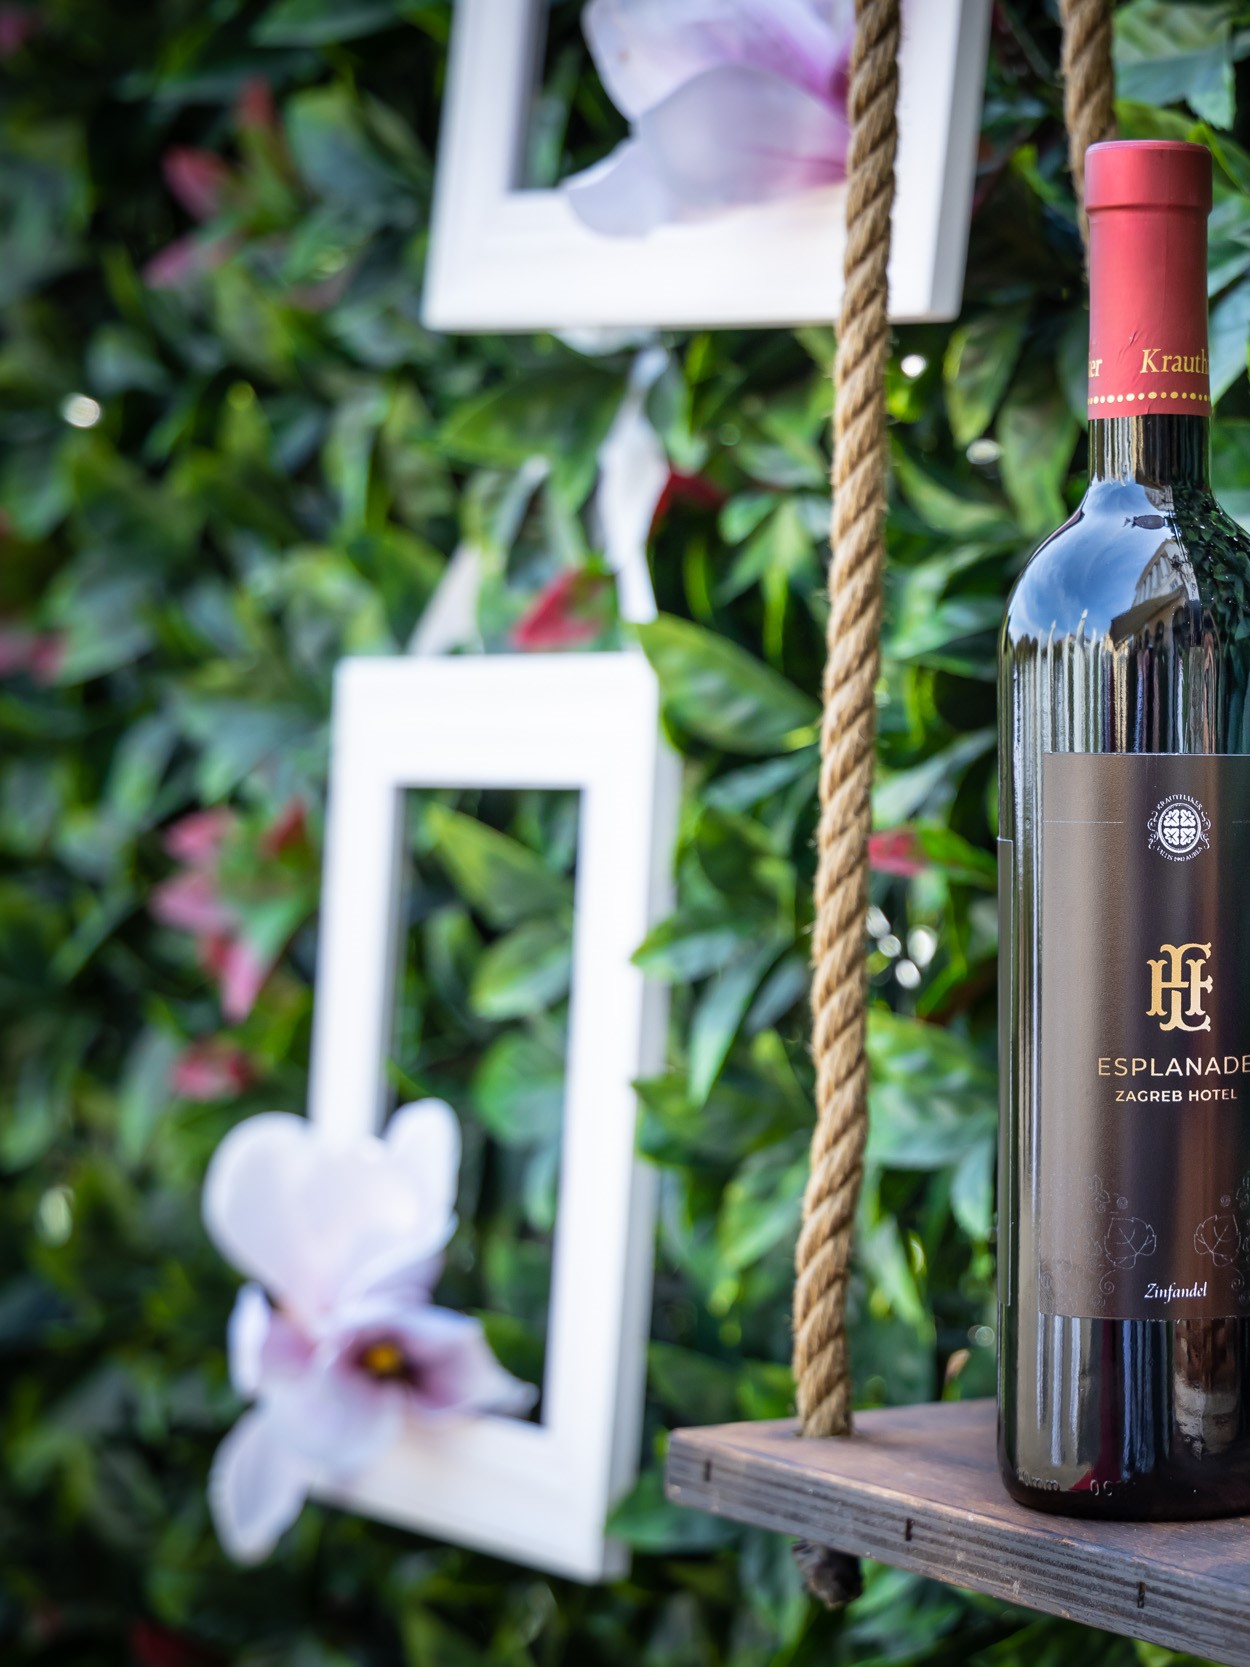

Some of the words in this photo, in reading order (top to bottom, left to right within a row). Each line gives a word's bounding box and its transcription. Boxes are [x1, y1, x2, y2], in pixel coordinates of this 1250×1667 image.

[1115, 1090, 1183, 1103] ZAGREB
[1188, 1088, 1238, 1102] HOTEL
[1144, 1281, 1208, 1305] Zinfandel
